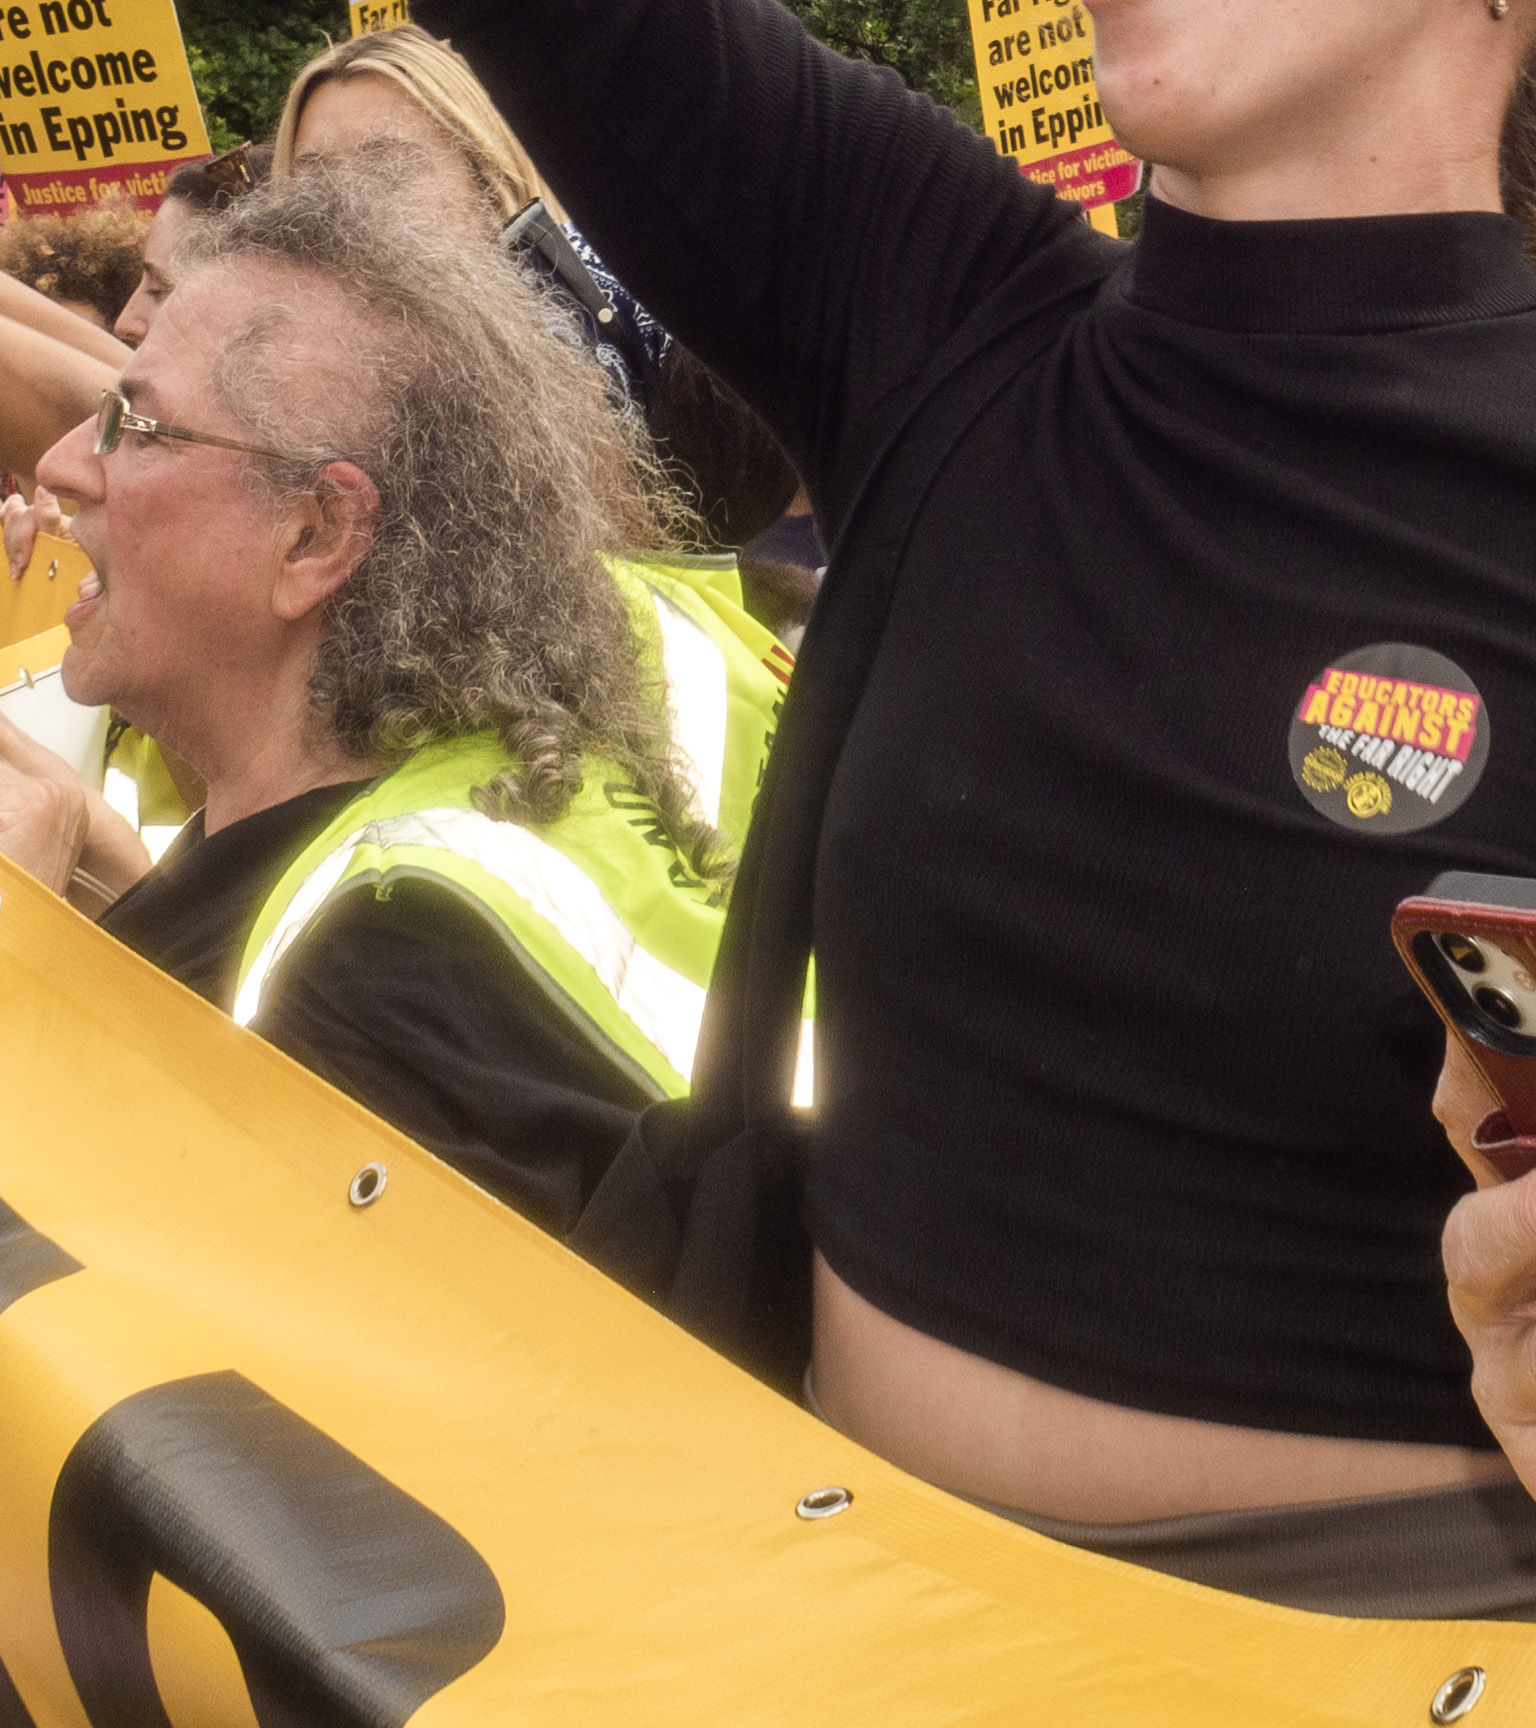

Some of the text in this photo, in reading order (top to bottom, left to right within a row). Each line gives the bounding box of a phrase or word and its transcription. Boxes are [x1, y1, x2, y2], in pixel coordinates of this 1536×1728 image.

[988, 5, 1086, 66] are not
[993, 56, 1094, 110] welcom
[40, 98, 188, 162] Epping
[998, 94, 1103, 154] in Eppi
[22, 180, 88, 206] Justice
[125, 171, 168, 197] victi
[1029, 169, 1056, 185] tice
[1057, 161, 1080, 181] for
[1305, 688, 1470, 755] AGAINST
[1324, 670, 1475, 723] EDUCATORS
[1318, 723, 1464, 804] THE FAR RIGHT
